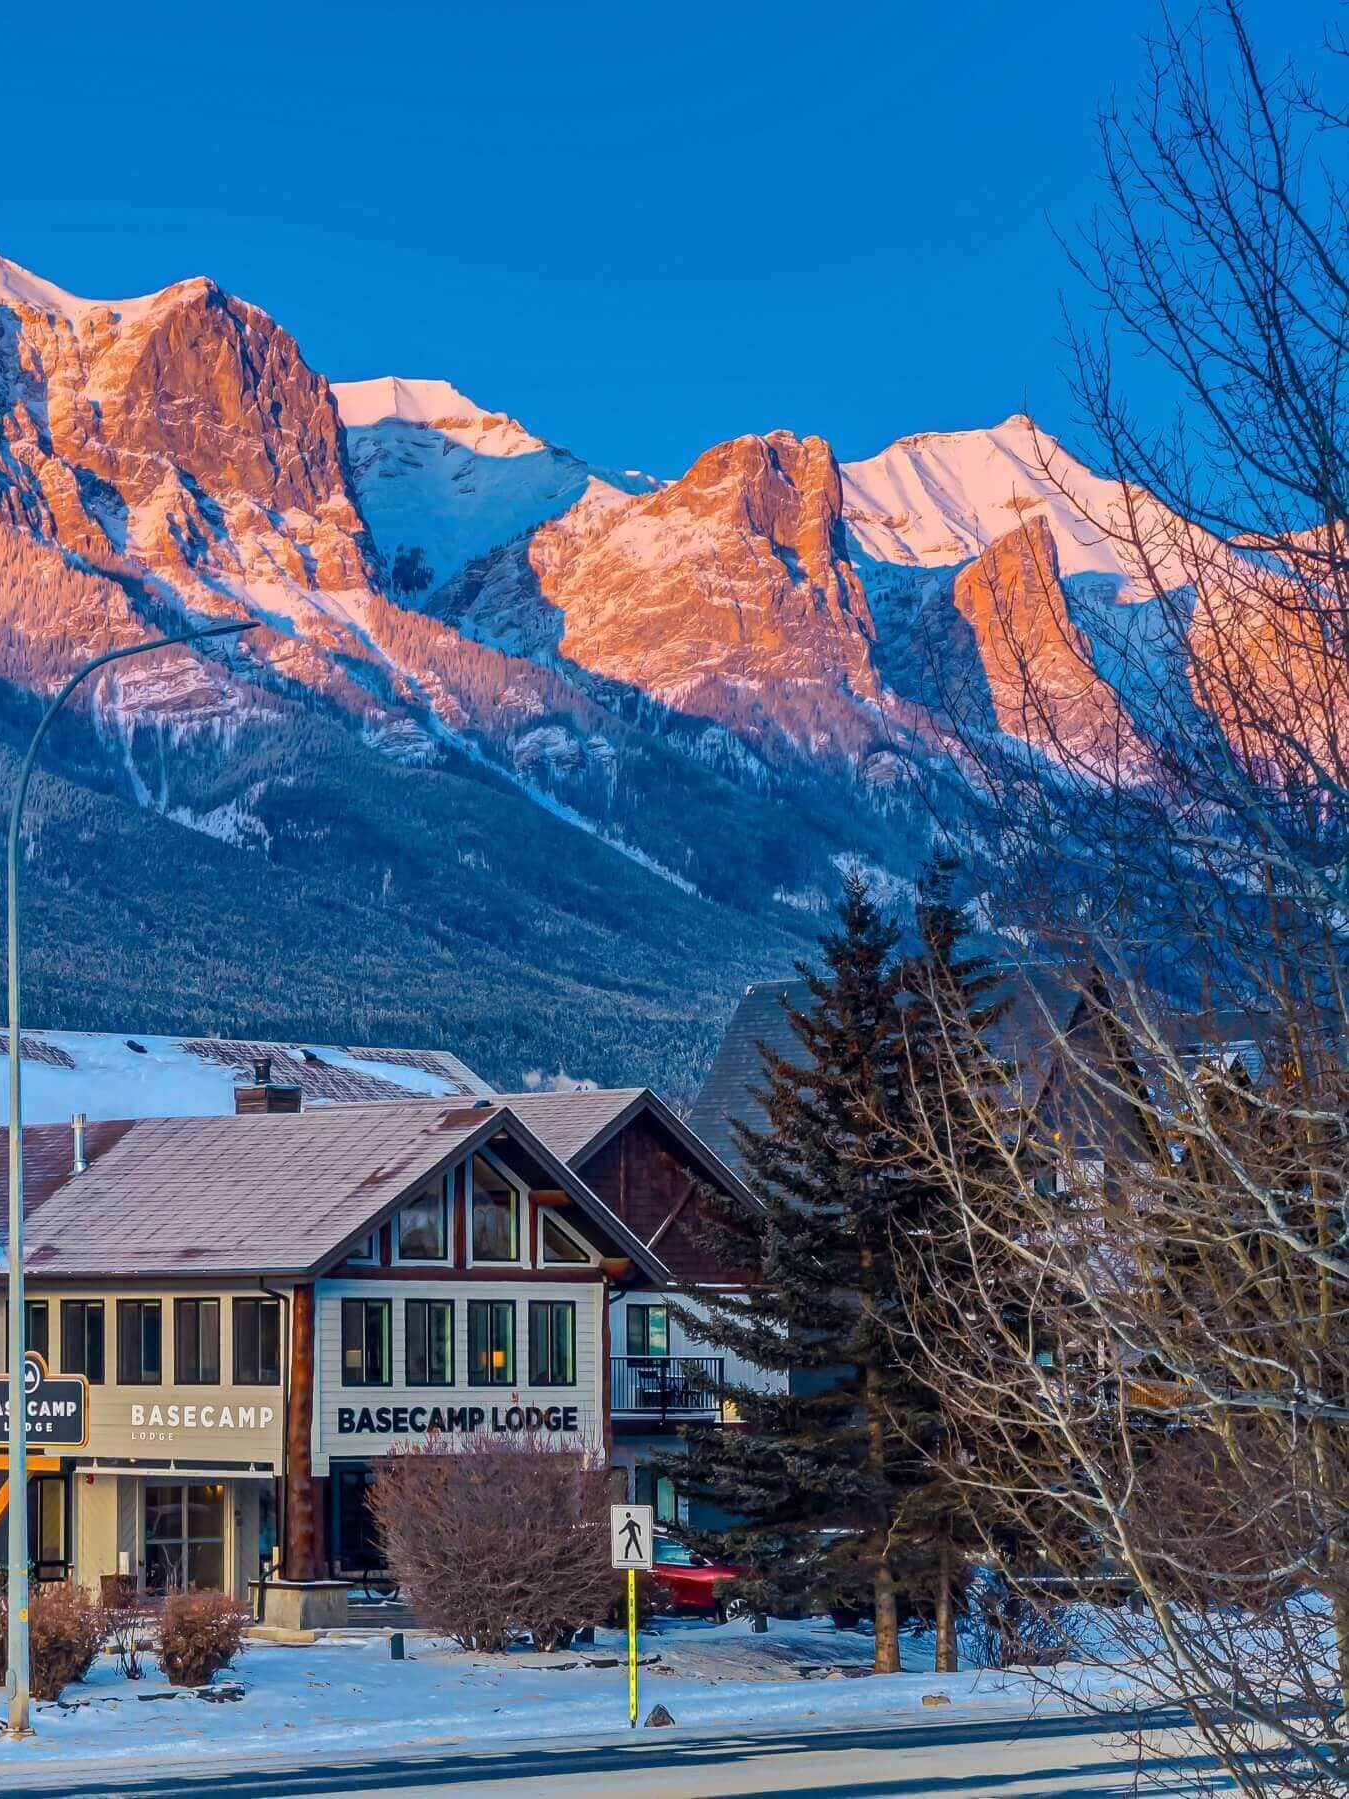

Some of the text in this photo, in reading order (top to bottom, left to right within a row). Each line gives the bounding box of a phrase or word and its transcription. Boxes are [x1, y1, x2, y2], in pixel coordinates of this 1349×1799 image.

[131, 1404, 274, 1429] BASECAMP
[337, 1406, 579, 1434] BASECAMP LODGE
[4, 1422, 53, 1432] LDGE
[131, 1432, 174, 1441] LODGE
